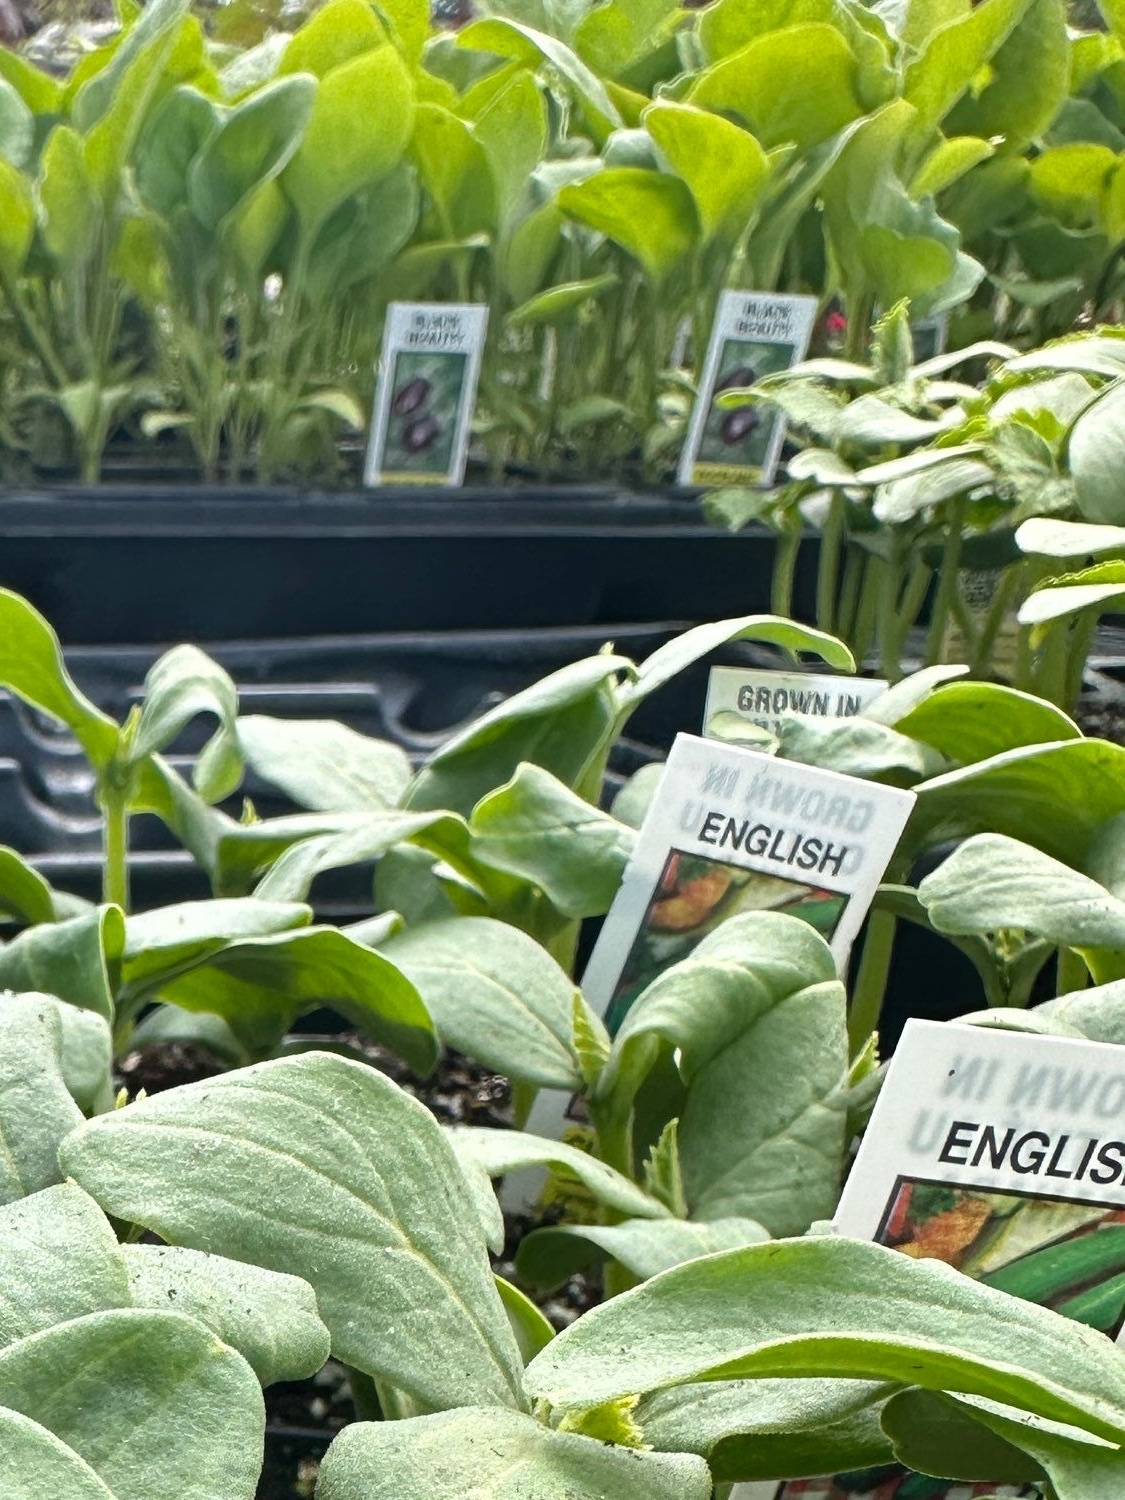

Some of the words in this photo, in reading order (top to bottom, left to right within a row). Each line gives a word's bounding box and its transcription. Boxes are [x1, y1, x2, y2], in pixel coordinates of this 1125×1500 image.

[737, 685, 829, 717] GROWN
[835, 693, 862, 718] IN
[697, 811, 849, 878] ENGLISH
[937, 1120, 1125, 1187] ENGLIS
